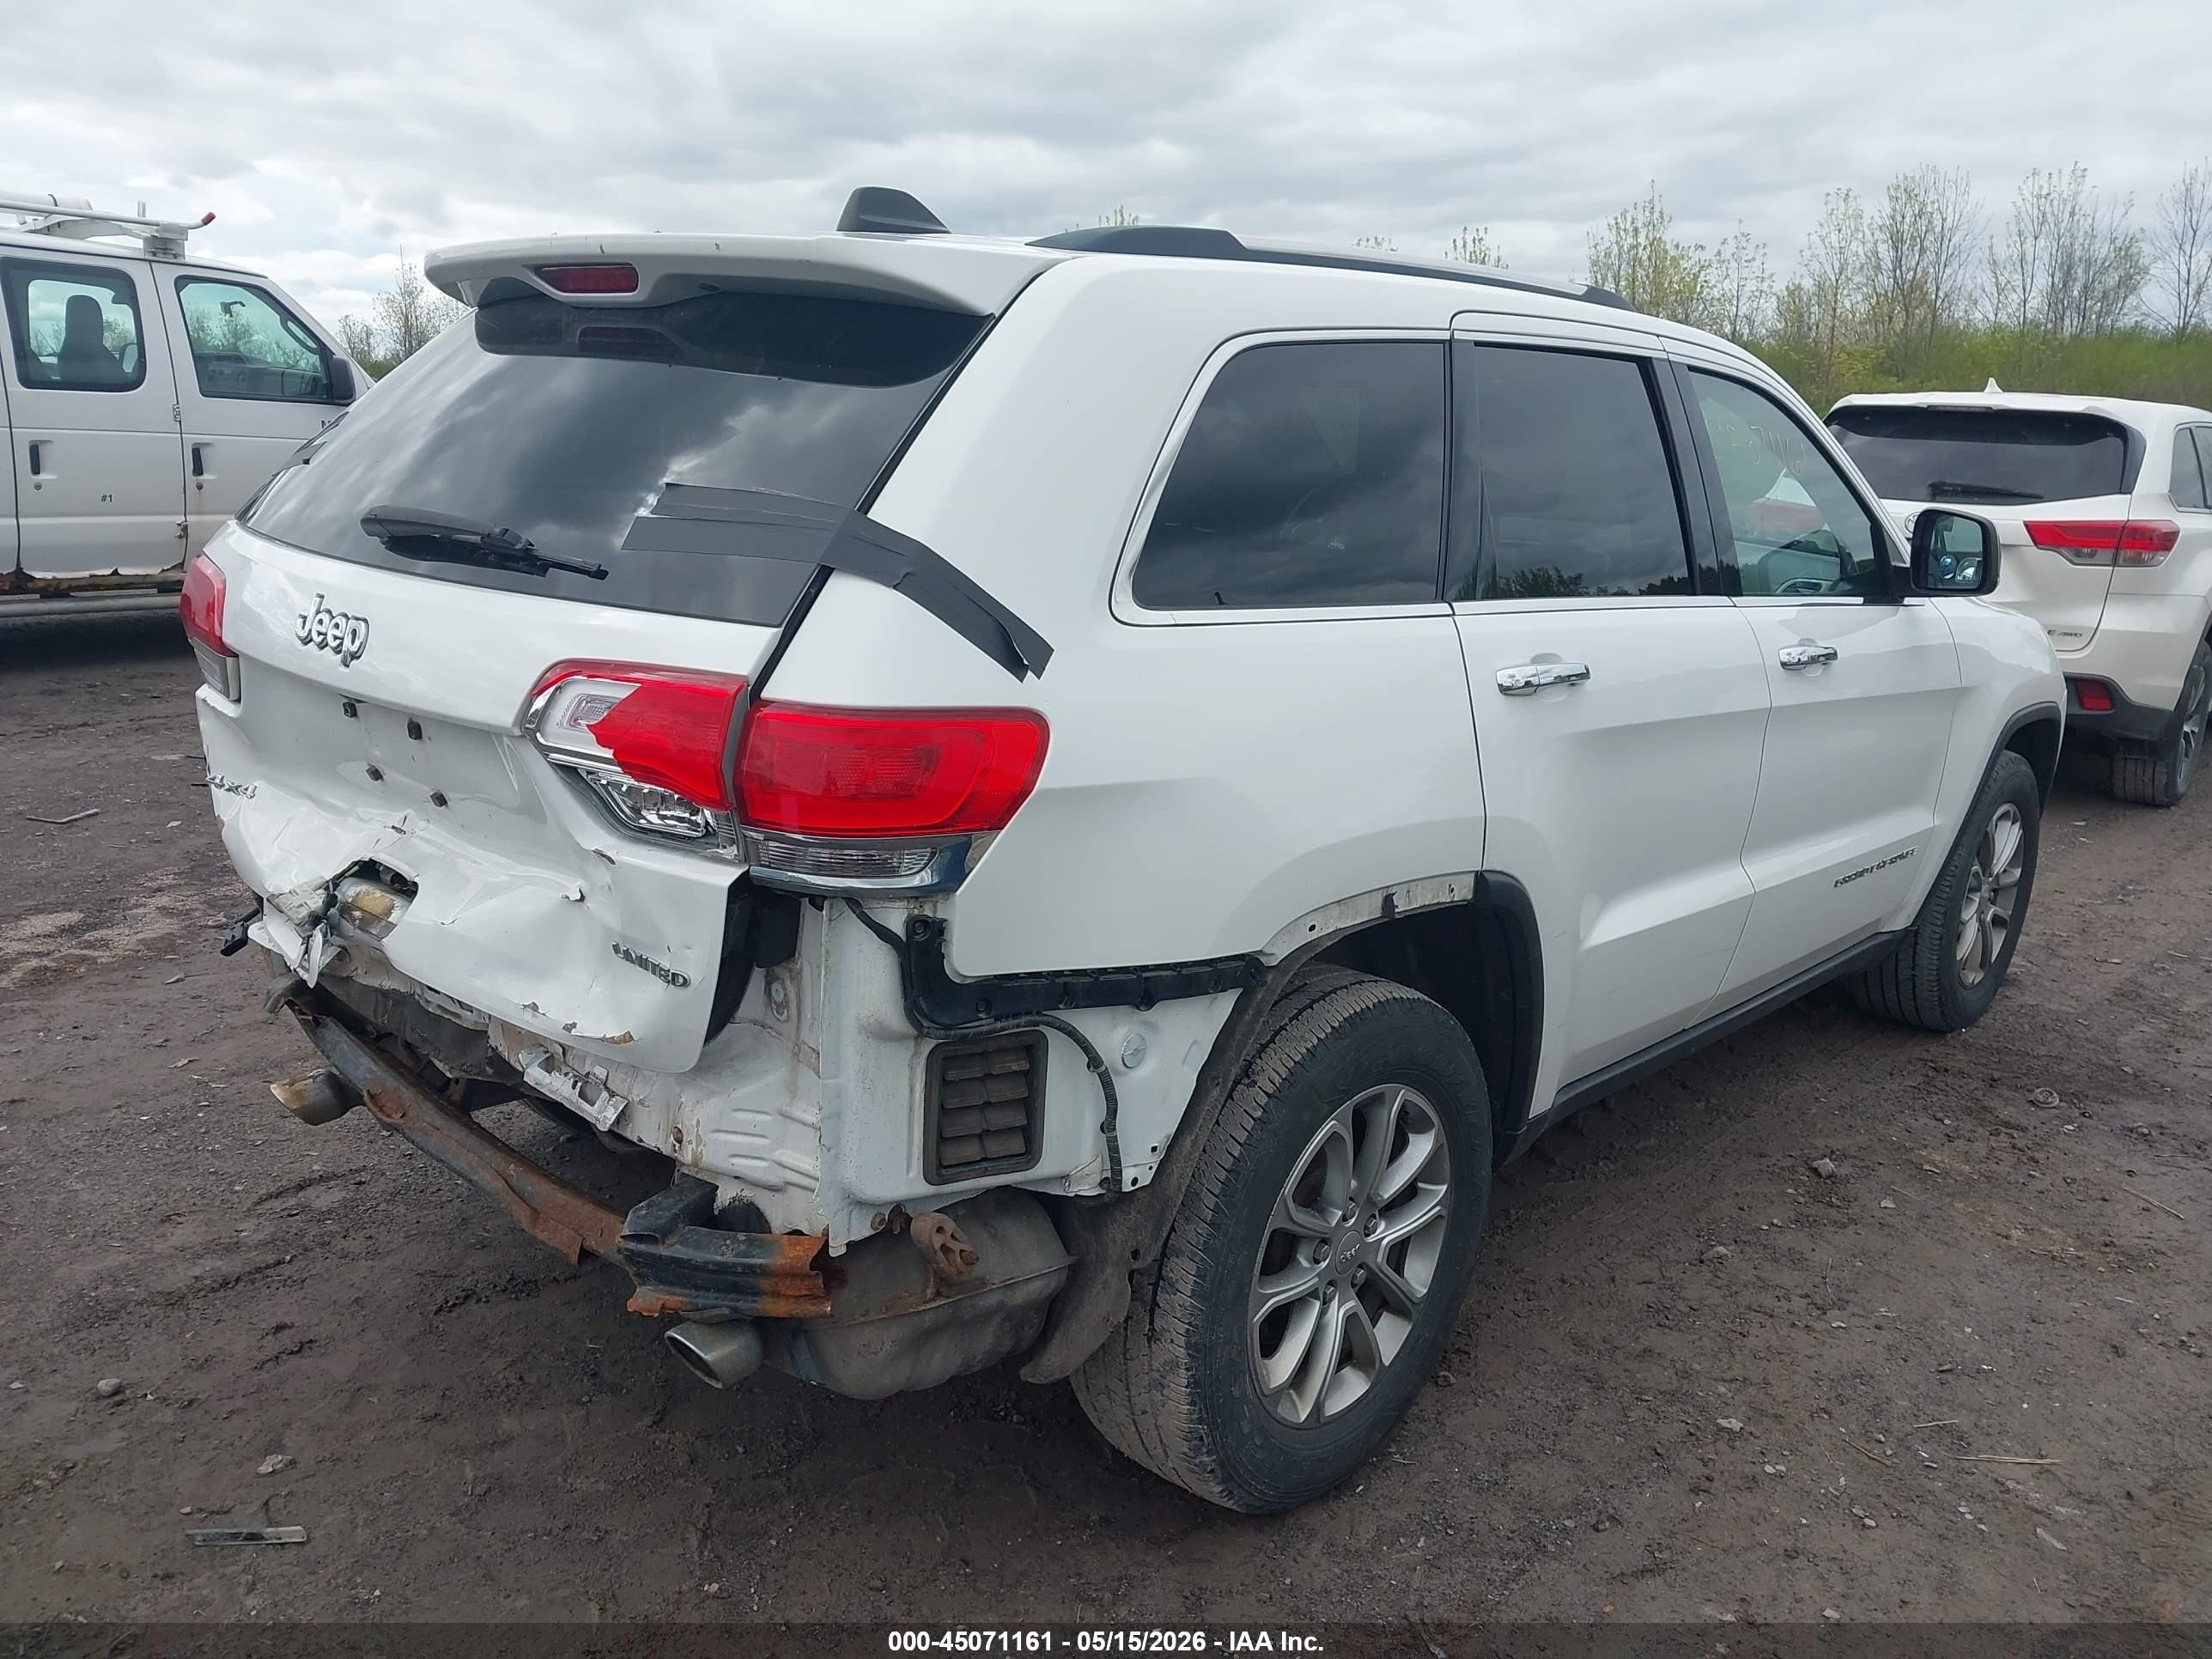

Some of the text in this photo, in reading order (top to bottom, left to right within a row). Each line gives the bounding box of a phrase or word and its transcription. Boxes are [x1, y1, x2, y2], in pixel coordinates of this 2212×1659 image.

[101, 494, 112, 502] #1
[295, 592, 369, 668] Jeep
[611, 941, 691, 988] LIMITED
